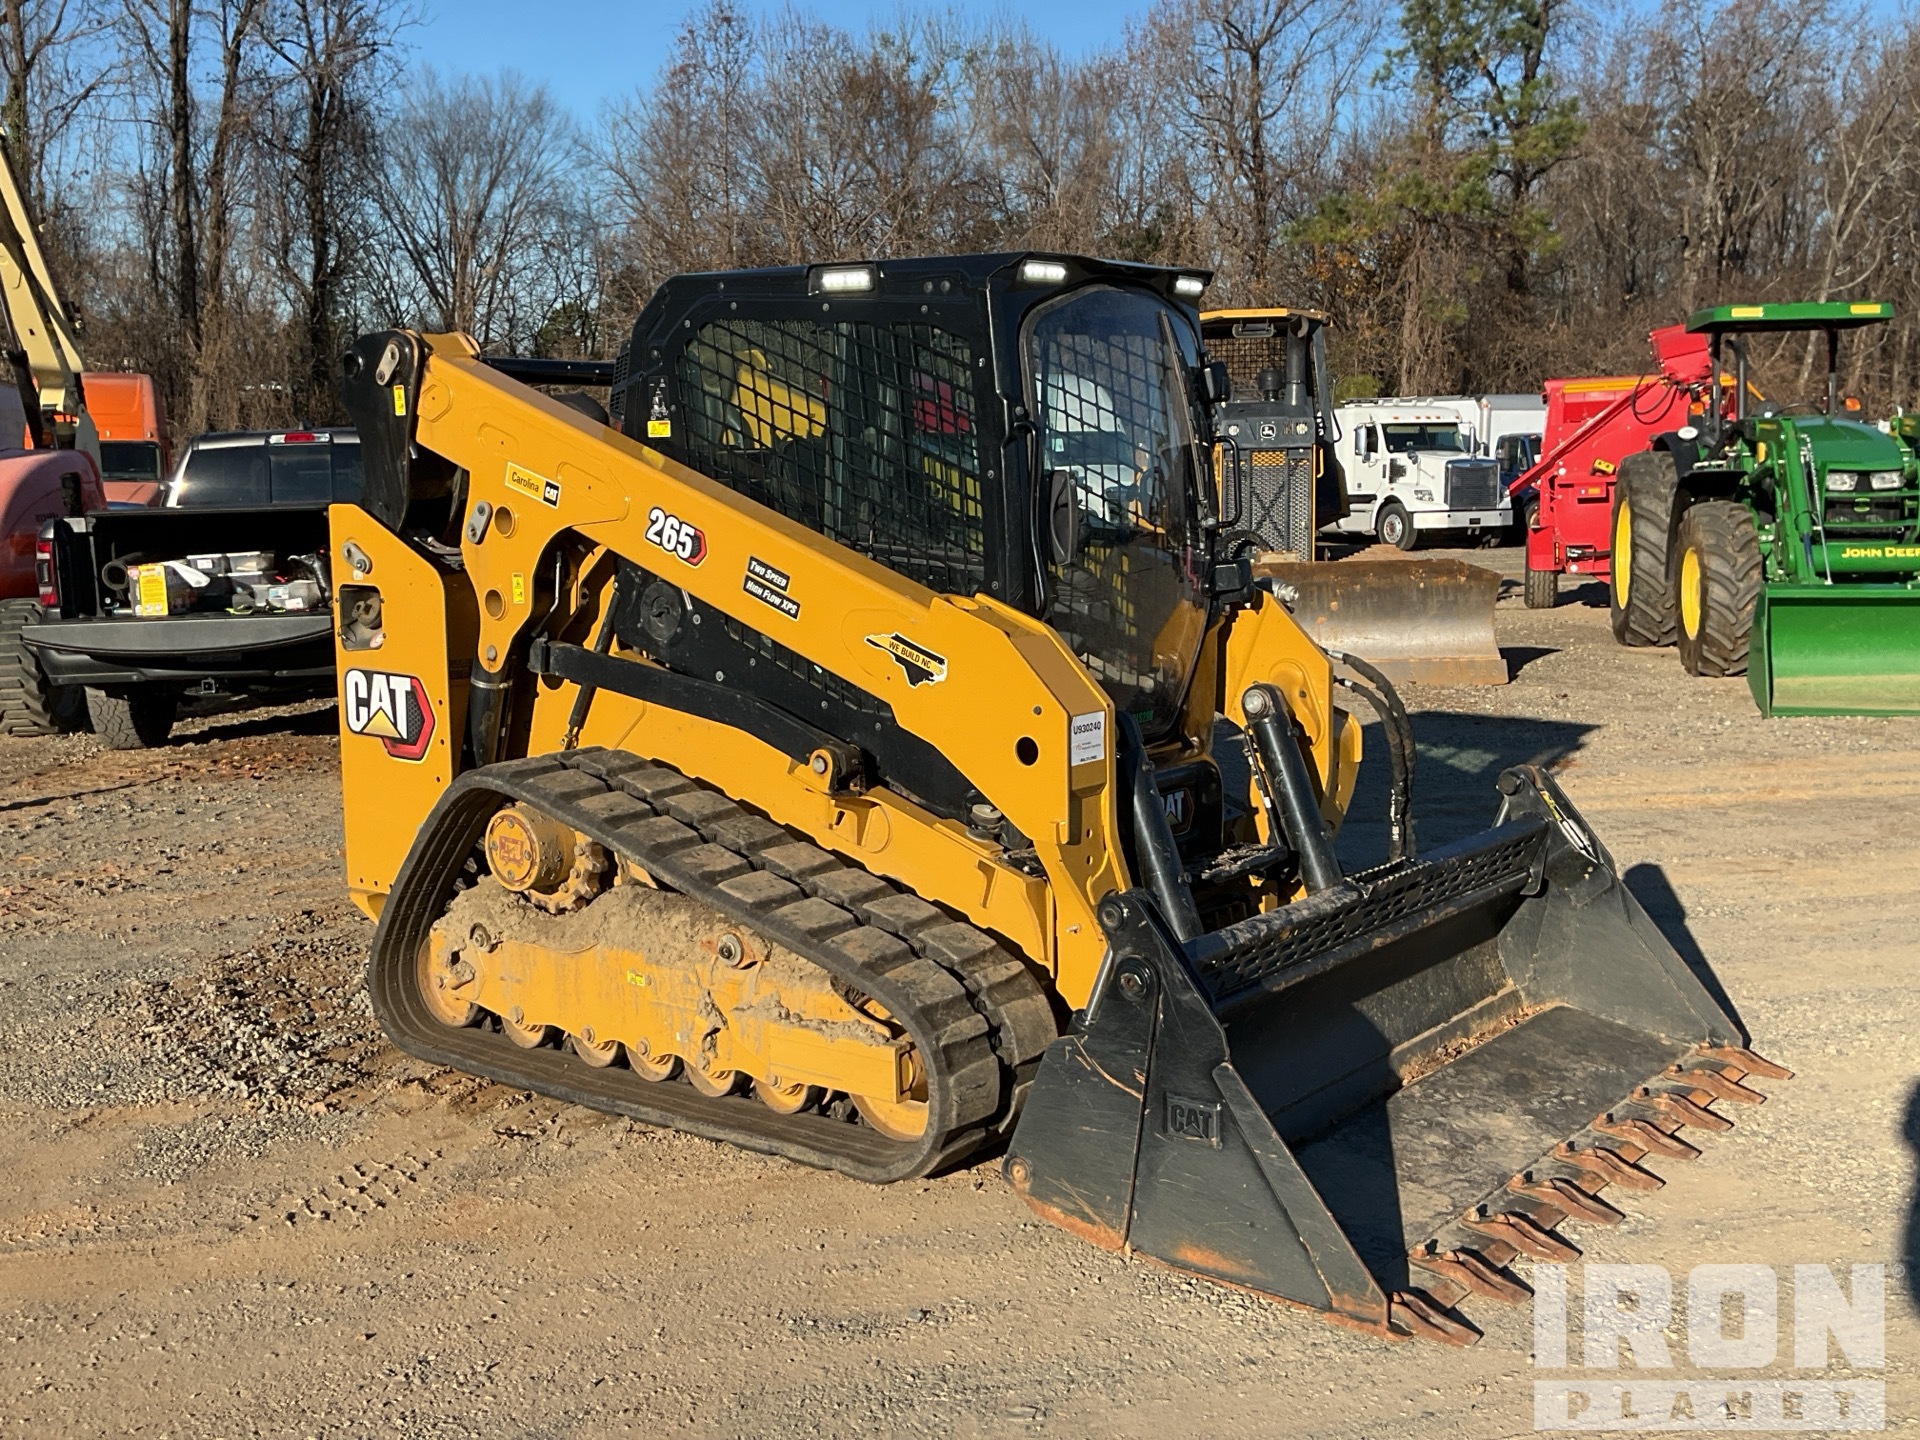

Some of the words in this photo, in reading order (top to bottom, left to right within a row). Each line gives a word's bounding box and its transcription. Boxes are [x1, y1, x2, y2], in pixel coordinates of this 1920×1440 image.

[511, 471, 539, 493] Carolina
[544, 486, 559, 502] CAT
[646, 508, 696, 559] 265
[1841, 547, 1883, 558] JOHN
[780, 599, 798, 614] XPS
[888, 640, 901, 653] WE
[900, 647, 921, 664] BUILD
[920, 657, 932, 669] NC
[345, 669, 412, 740] CAT
[1073, 720, 1102, 735] U930240
[1170, 1104, 1212, 1139] CAT
